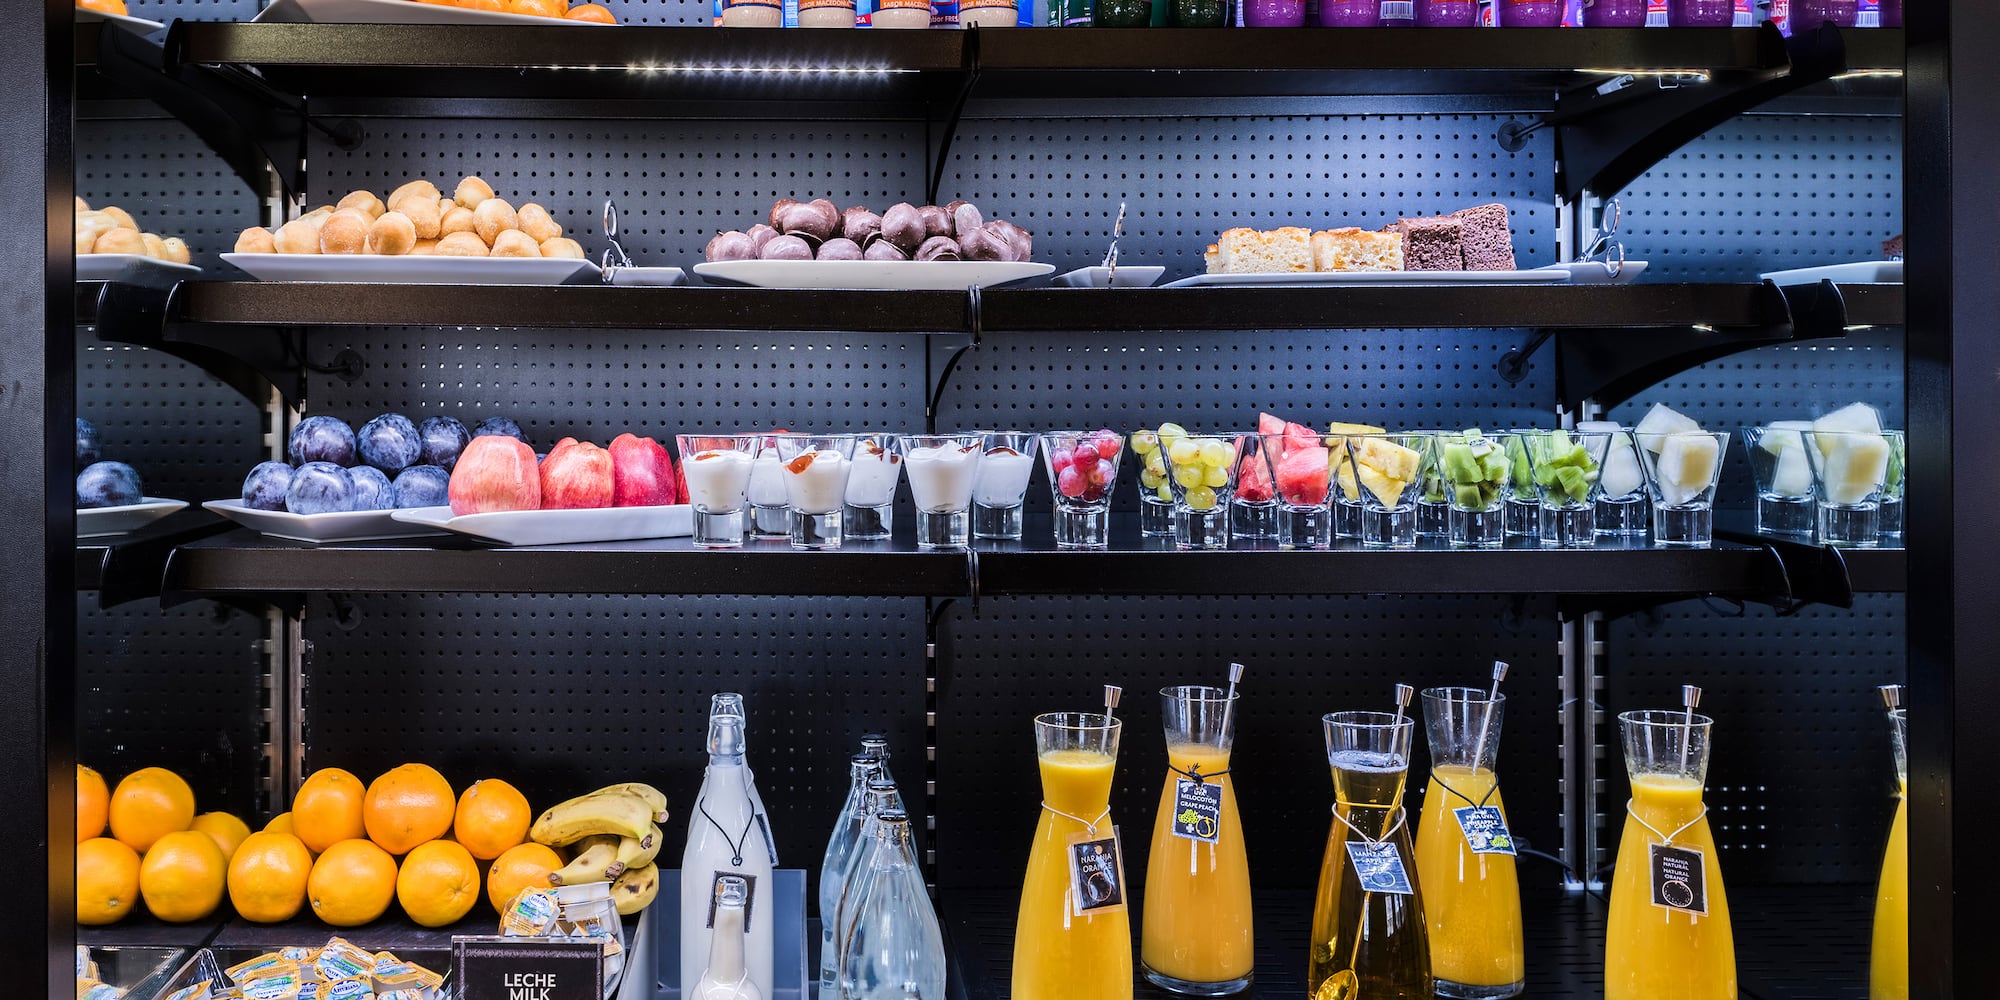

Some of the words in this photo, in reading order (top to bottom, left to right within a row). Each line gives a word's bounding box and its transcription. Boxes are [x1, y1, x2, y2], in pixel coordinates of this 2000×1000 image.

[1181, 793, 1217, 805] MELOCOTÓN
[1180, 801, 1198, 809] GRAPE
[1198, 804, 1217, 812] PEACH
[1663, 857, 1689, 865] NARANJA
[1663, 862, 1689, 871] NATURAL
[1663, 868, 1690, 877] NATURAL
[1664, 874, 1689, 882] ORANGE
[504, 973, 557, 988] LECHE
[509, 988, 551, 1000] MILK
